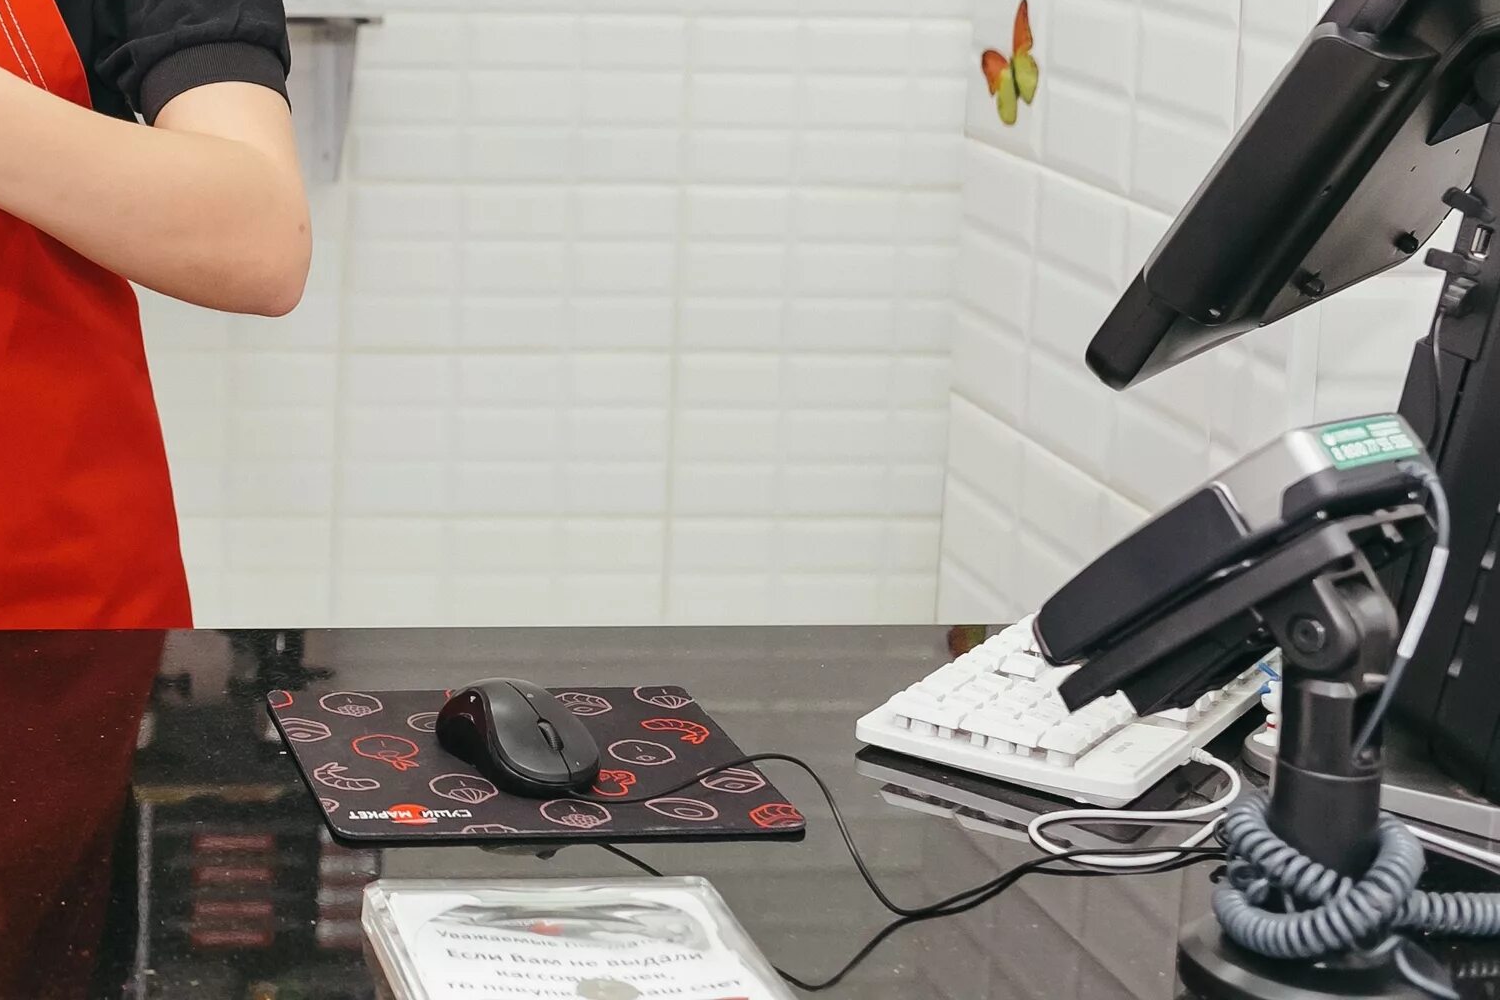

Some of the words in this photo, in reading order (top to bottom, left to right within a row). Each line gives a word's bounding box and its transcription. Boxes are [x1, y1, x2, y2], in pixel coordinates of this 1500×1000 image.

[446, 948, 503, 962] Если
[510, 953, 562, 967] Вам
[607, 952, 704, 967] выдали
